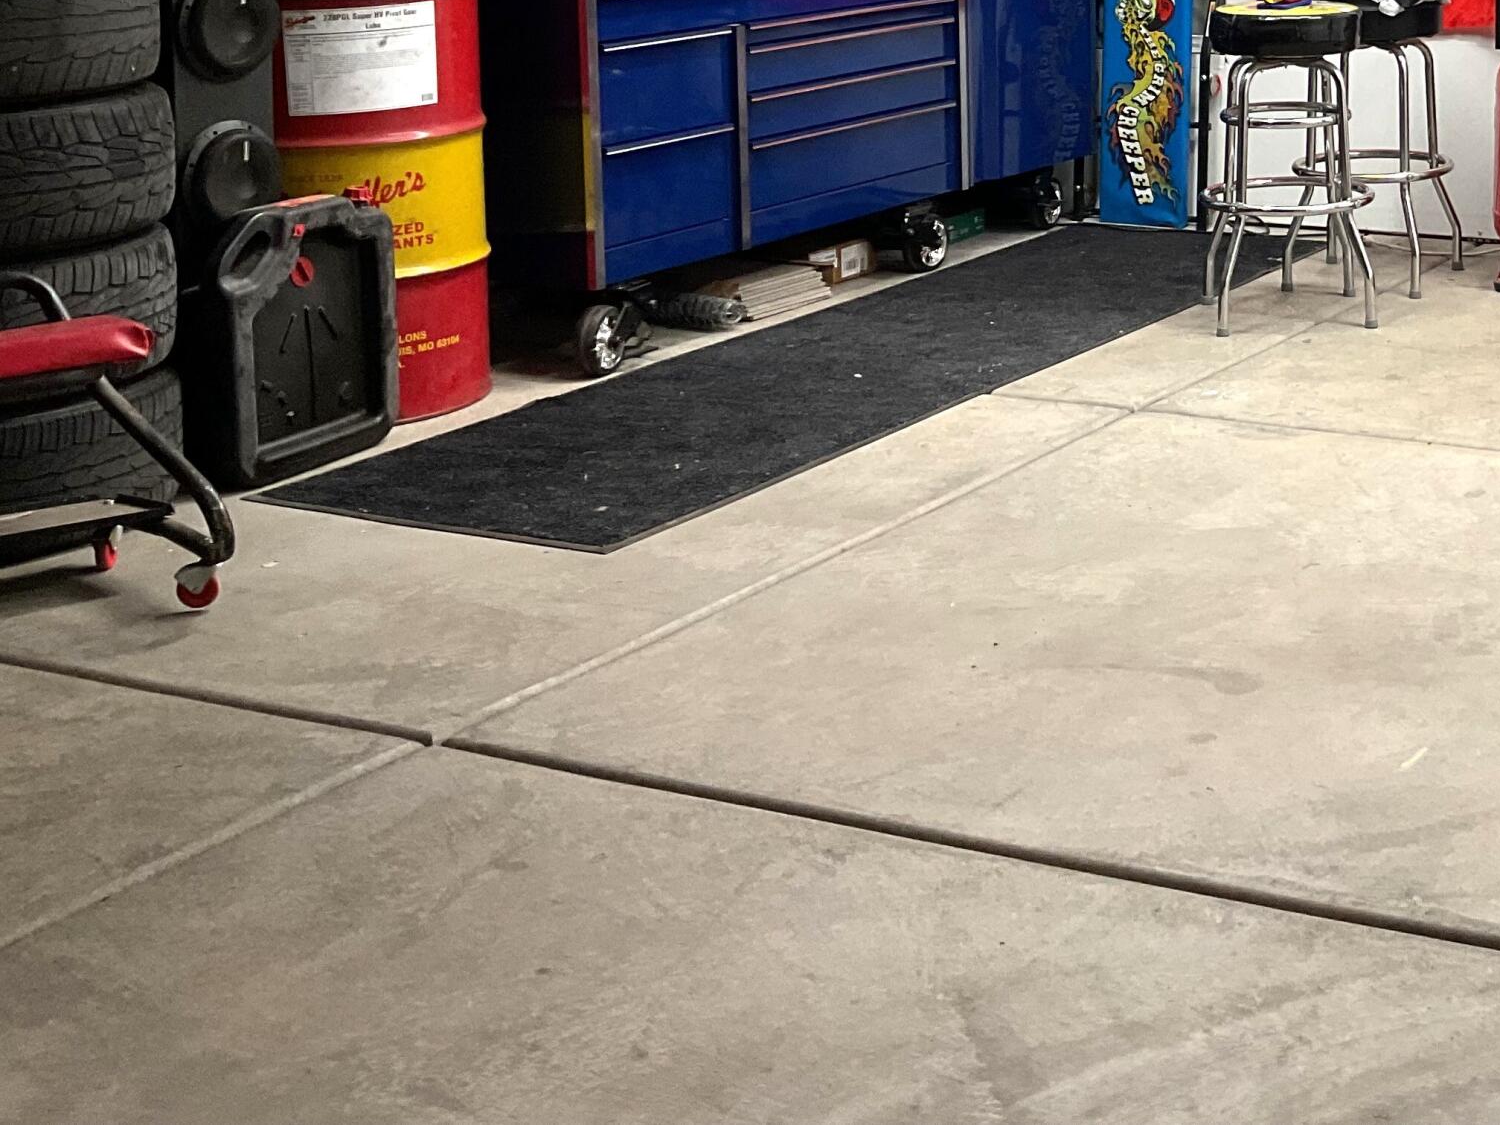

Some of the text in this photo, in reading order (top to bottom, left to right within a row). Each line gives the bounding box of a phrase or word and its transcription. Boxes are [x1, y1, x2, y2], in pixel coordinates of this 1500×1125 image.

[1132, 62, 1167, 107] GRIM
[1117, 105, 1154, 205] CREEPER
[392, 221, 424, 237] ZED
[393, 233, 434, 249] ANTS
[398, 330, 428, 344] LONS
[418, 341, 434, 352] MO
